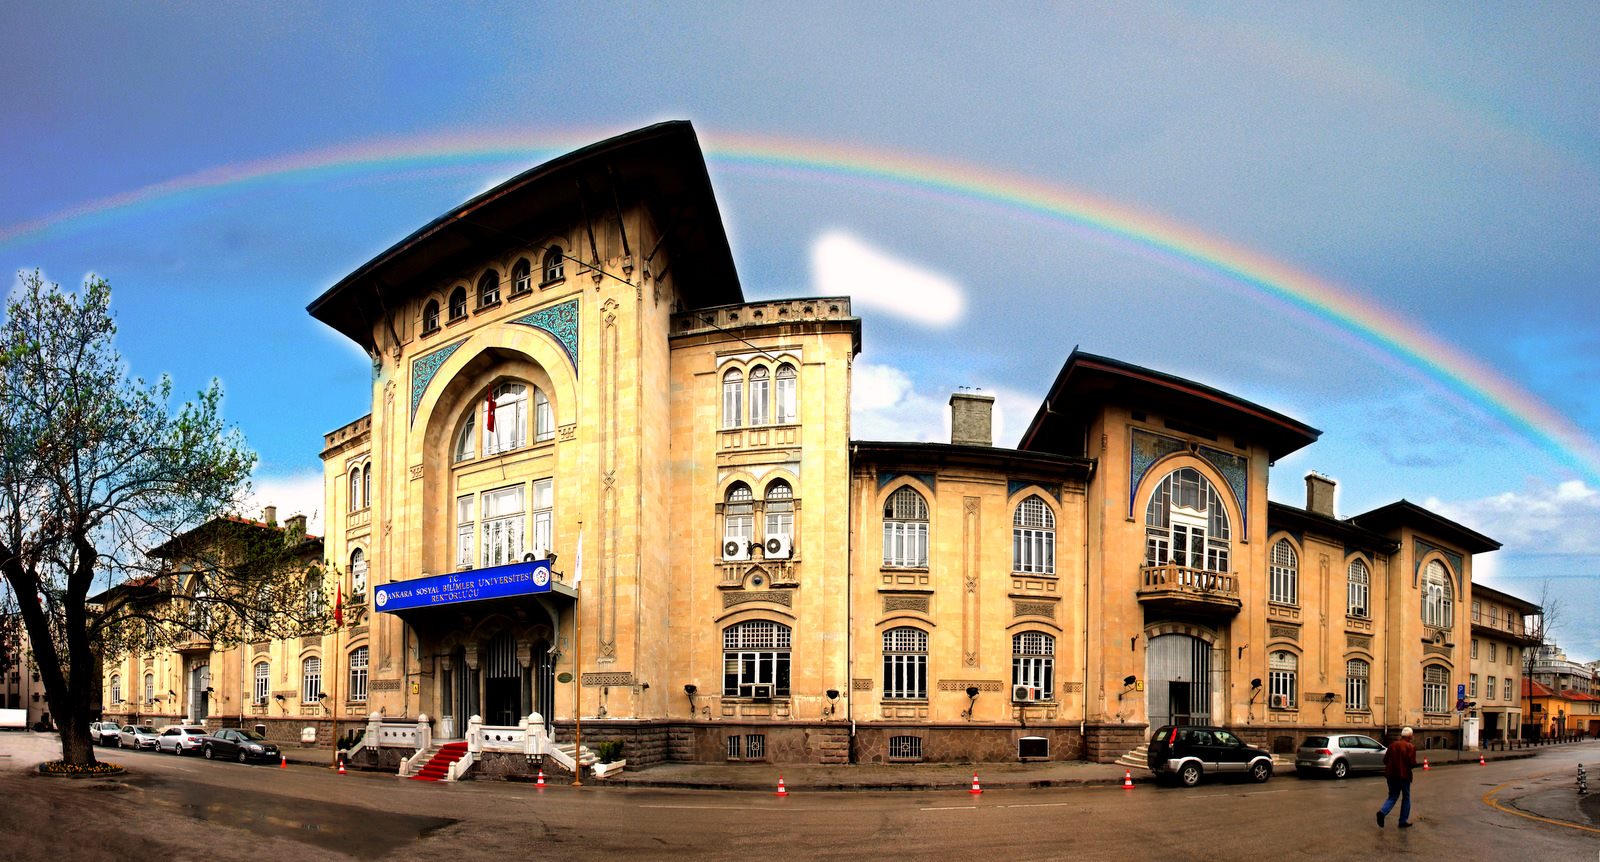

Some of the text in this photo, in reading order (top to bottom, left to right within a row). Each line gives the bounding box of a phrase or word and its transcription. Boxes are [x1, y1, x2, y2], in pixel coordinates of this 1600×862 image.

[448, 575, 461, 583] T.C.
[387, 590, 413, 600] ANKARA
[416, 586, 440, 596] SOSYAL
